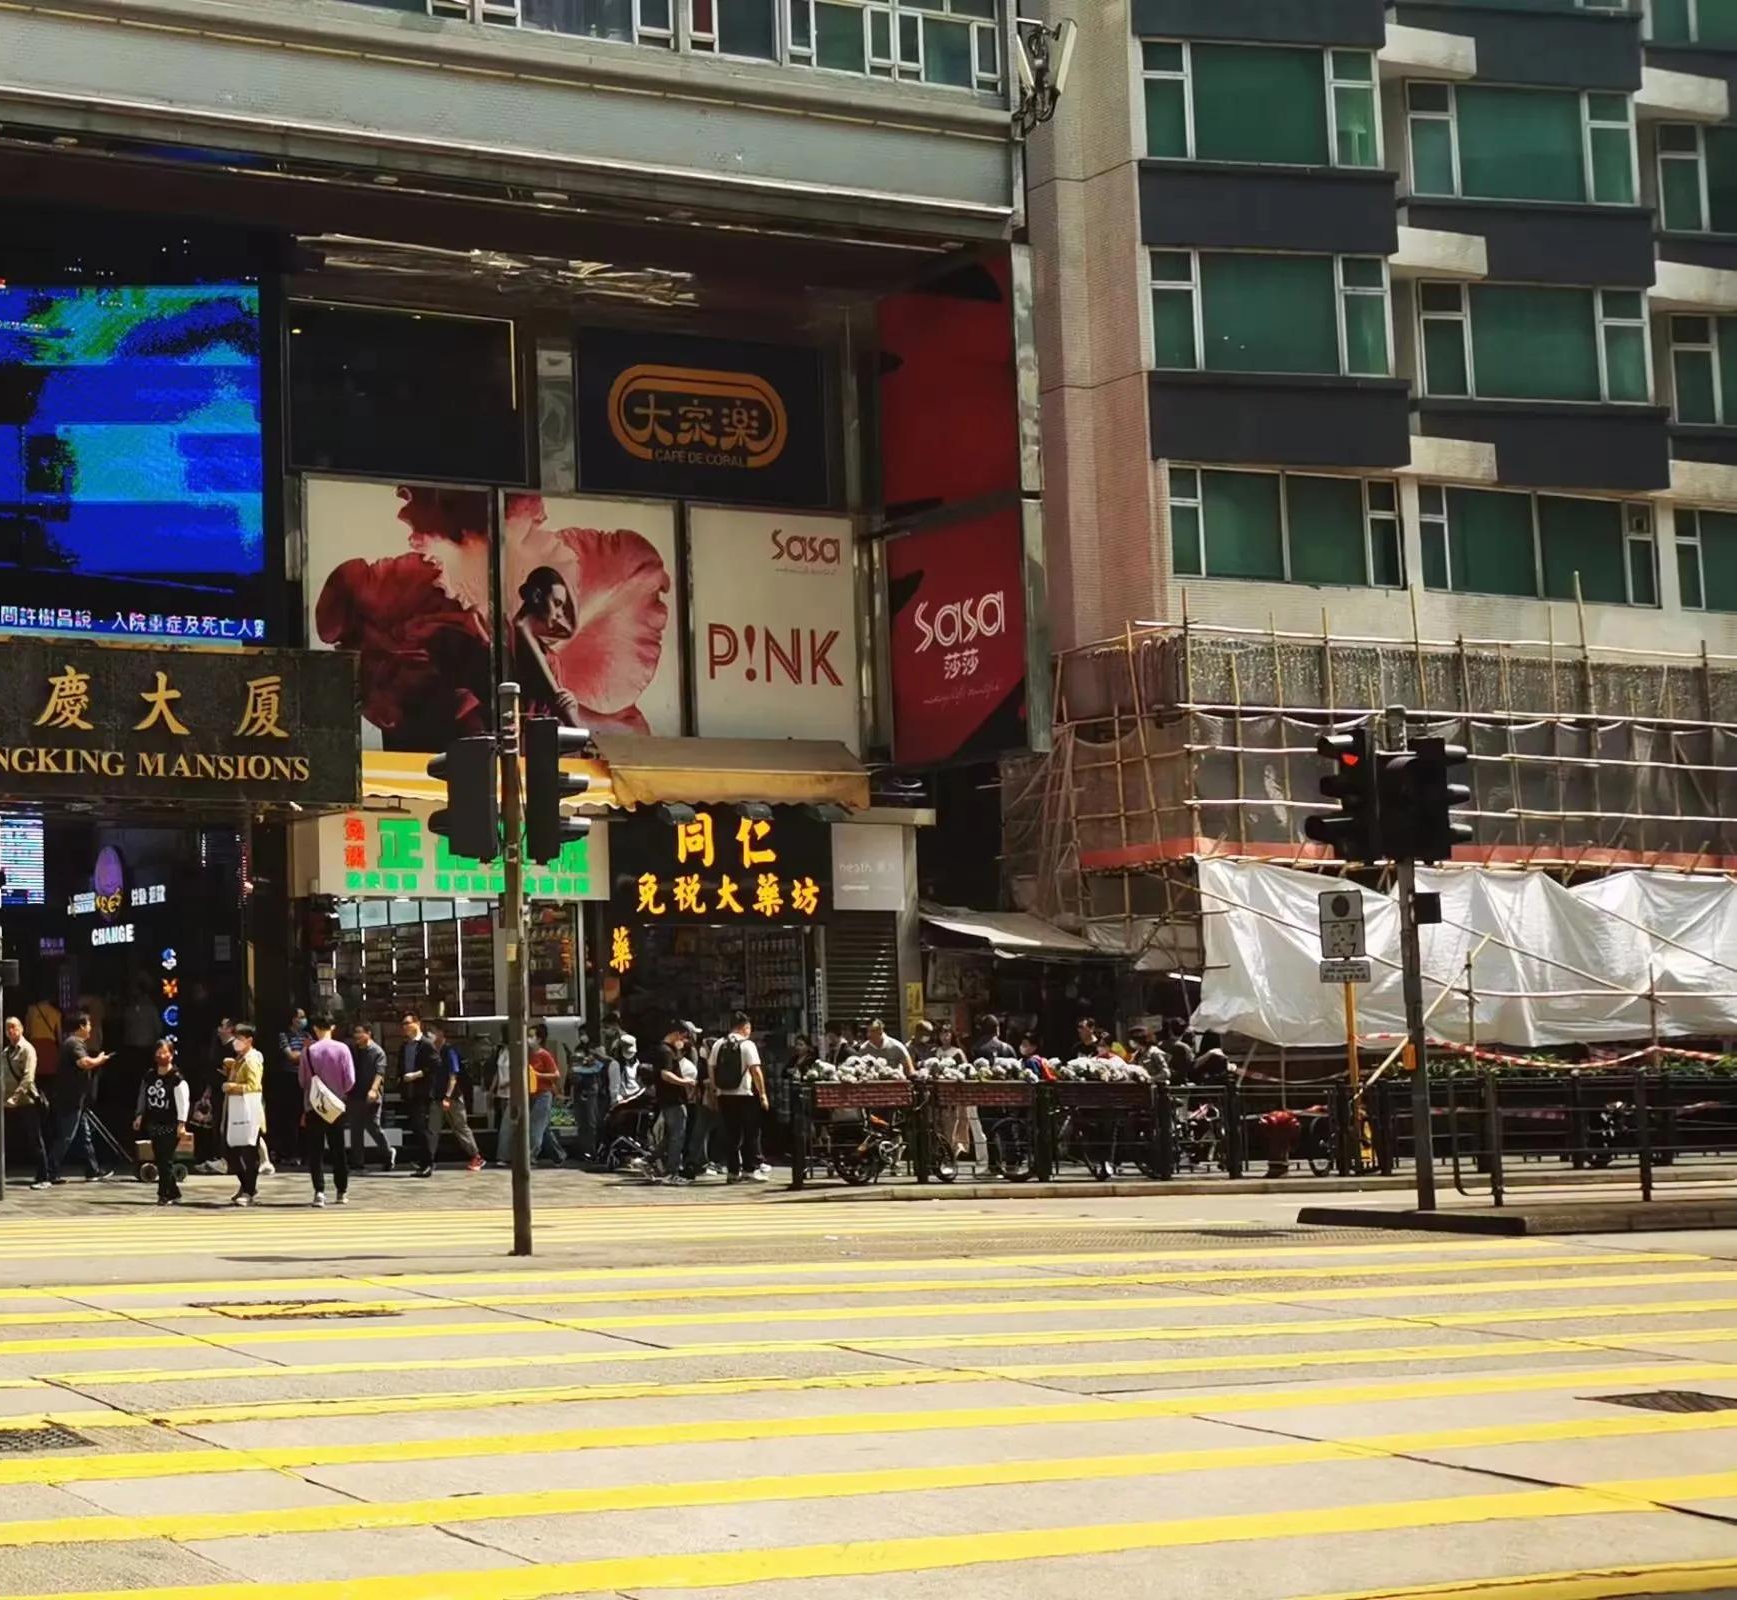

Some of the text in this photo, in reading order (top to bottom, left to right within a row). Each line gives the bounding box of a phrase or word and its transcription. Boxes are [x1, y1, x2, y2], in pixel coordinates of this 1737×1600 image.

[708, 622, 844, 687] P!NK
[944, 648, 979, 680] 莎莎
[135, 751, 310, 782] MANSIONS
[677, 812, 777, 869] 同仁
[91, 923, 135, 947] CHANGE
